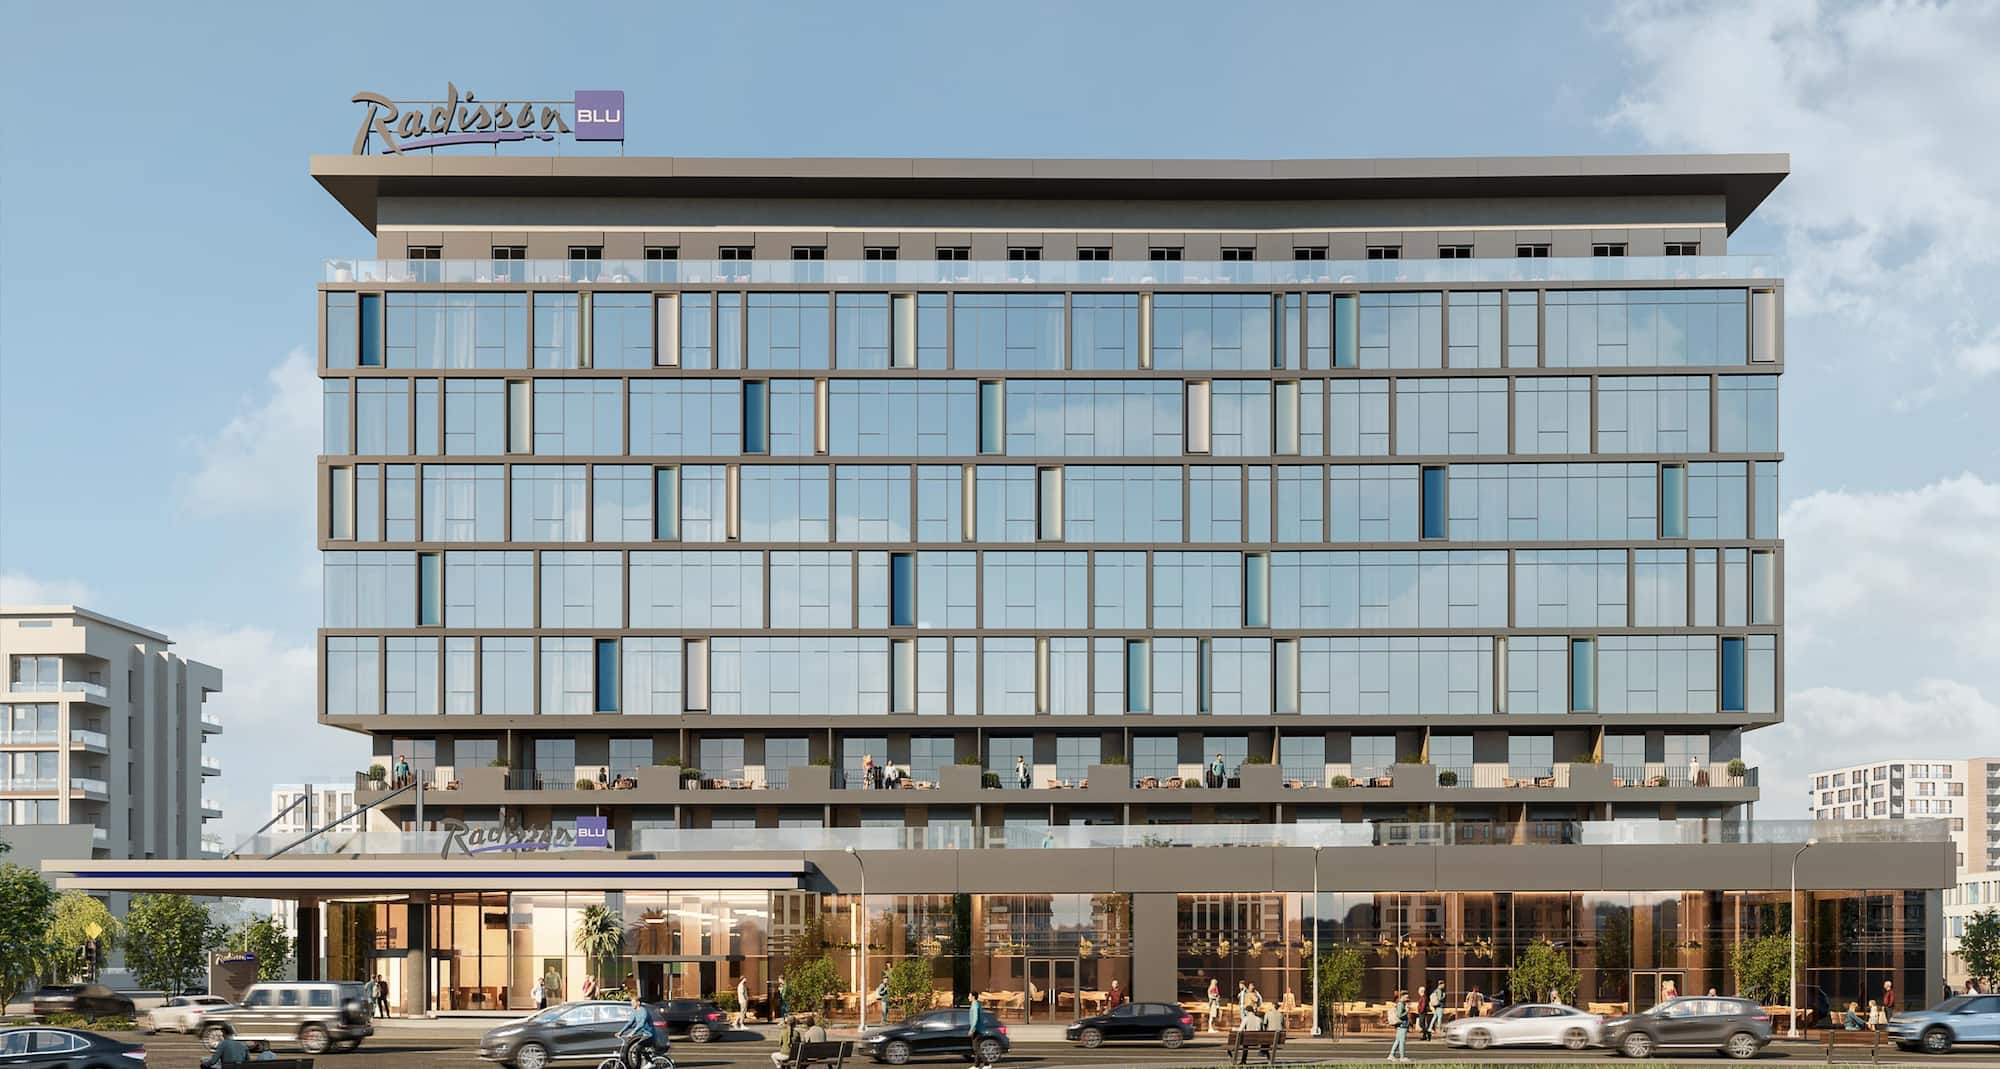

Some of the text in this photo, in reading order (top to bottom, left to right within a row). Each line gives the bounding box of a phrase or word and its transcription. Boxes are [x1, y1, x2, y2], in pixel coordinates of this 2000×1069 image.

[352, 81, 621, 156] Radisson BLU
[440, 806, 606, 860] Radisson BLU
